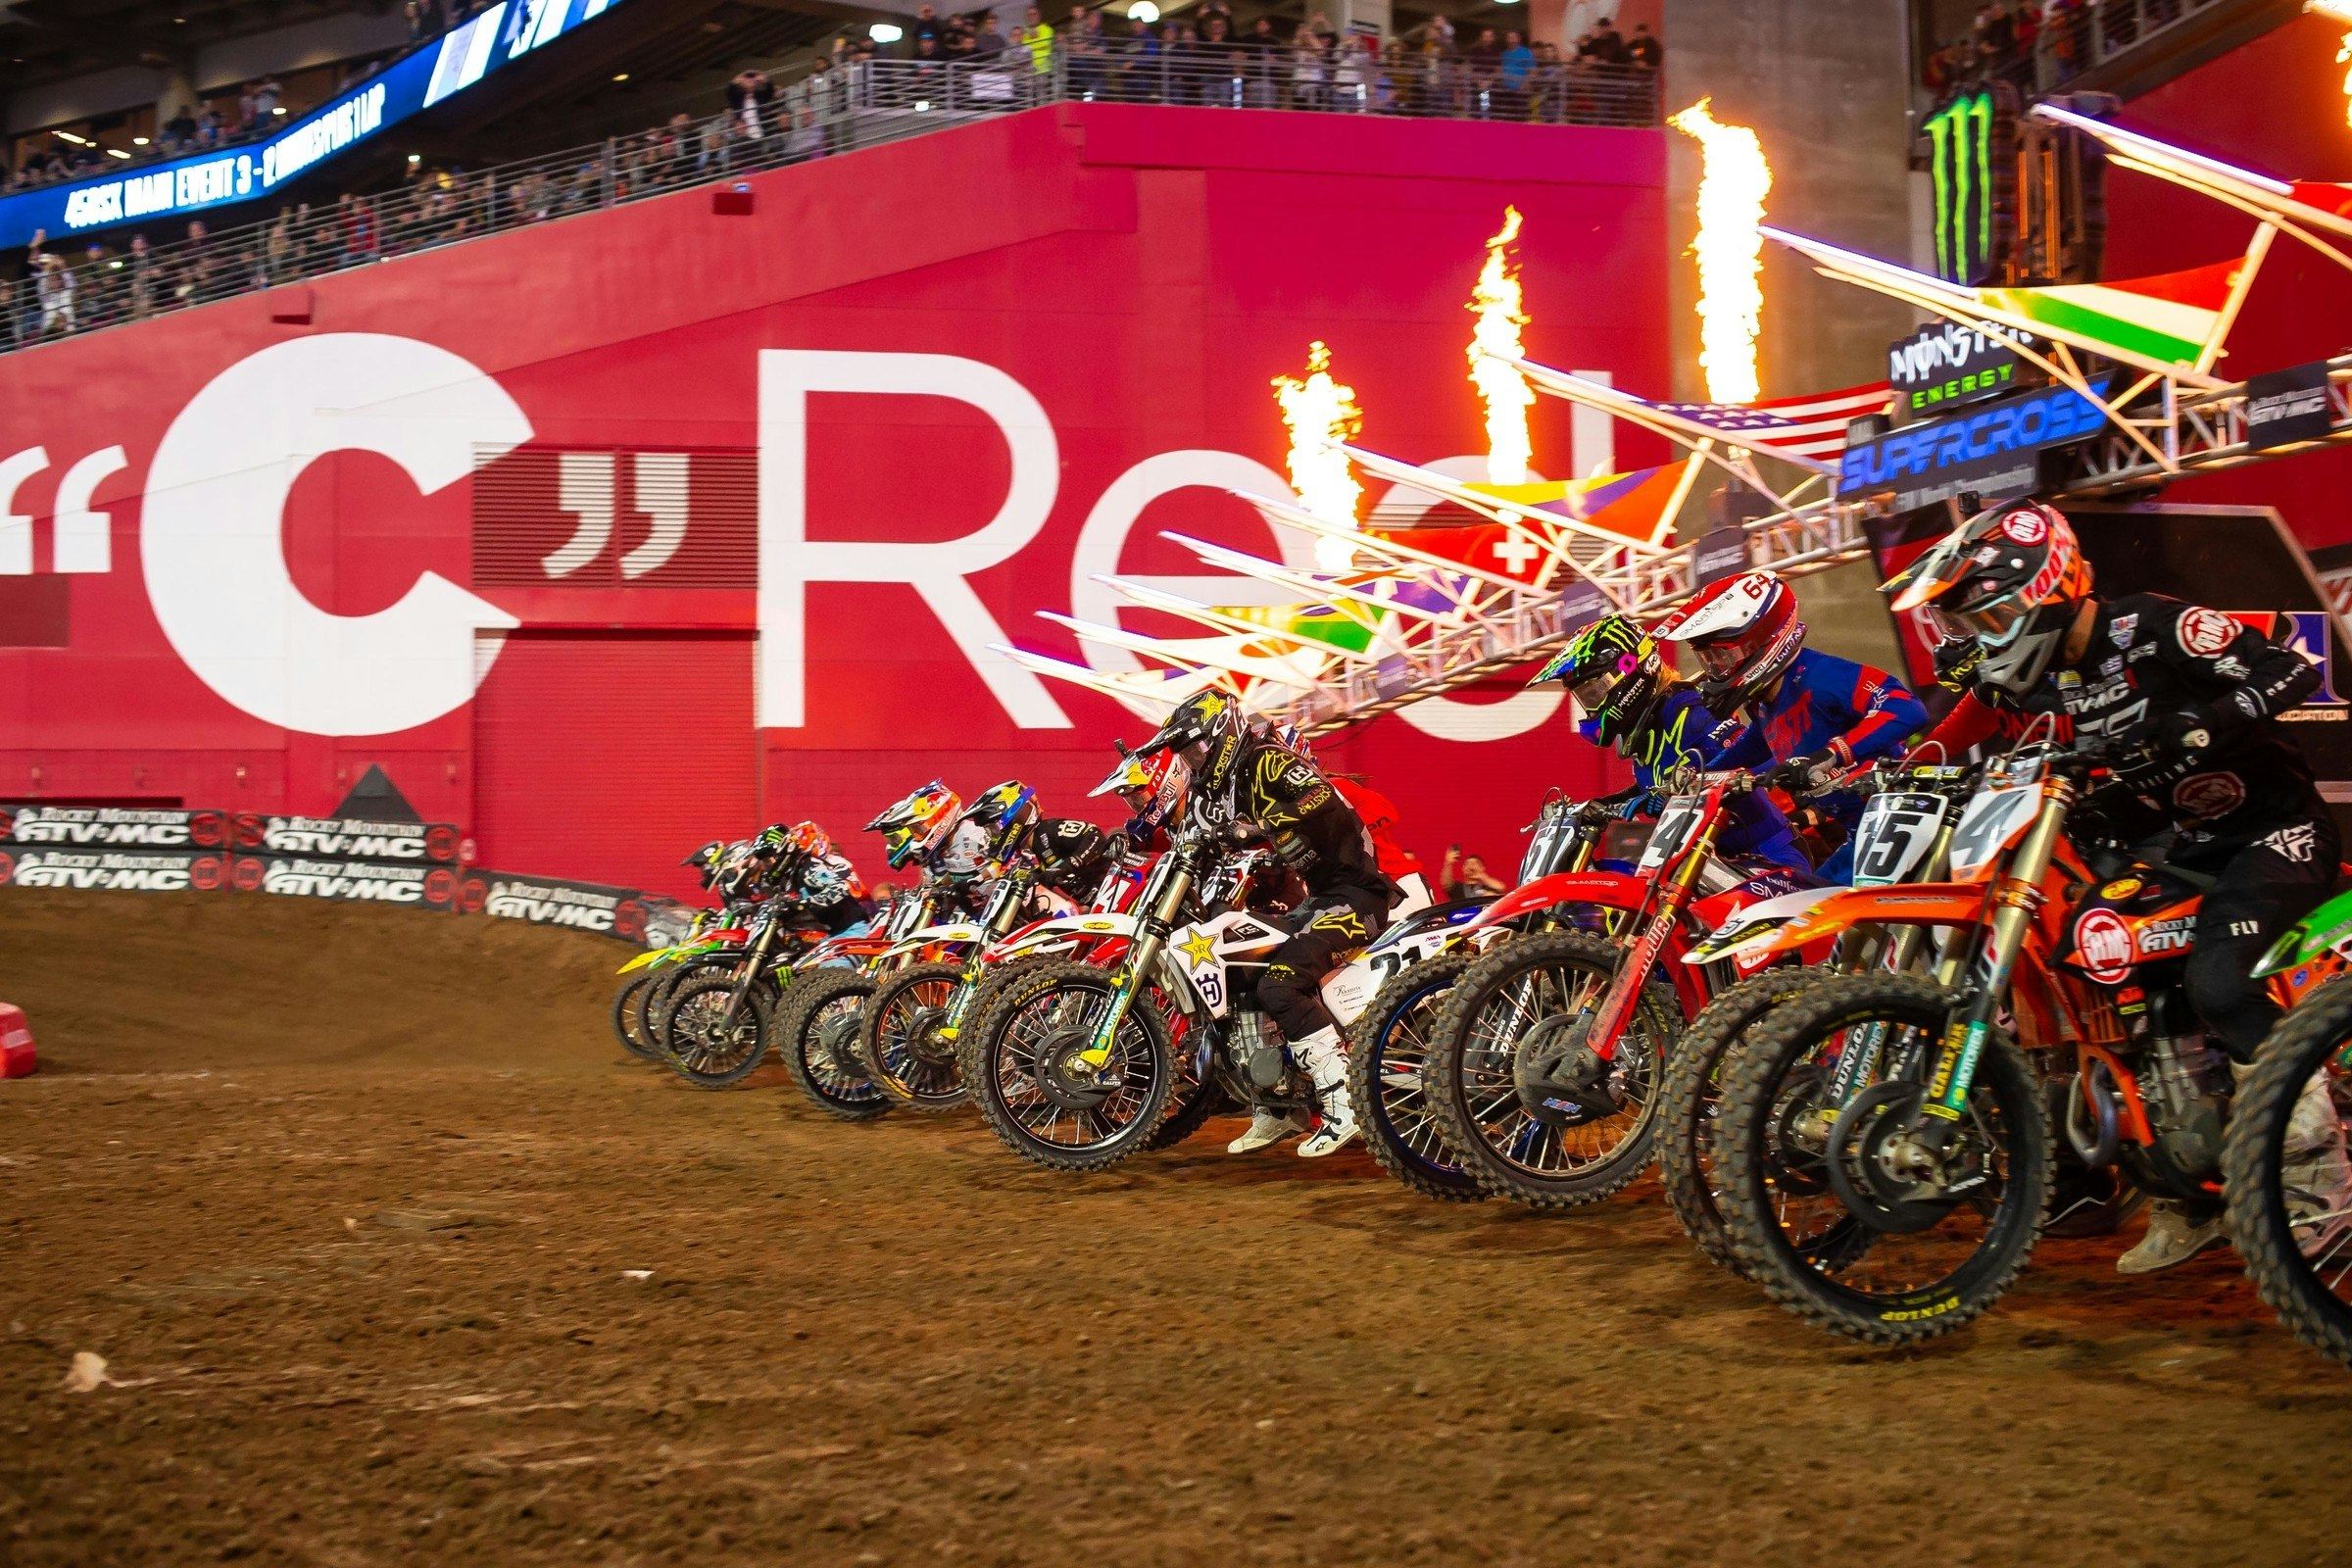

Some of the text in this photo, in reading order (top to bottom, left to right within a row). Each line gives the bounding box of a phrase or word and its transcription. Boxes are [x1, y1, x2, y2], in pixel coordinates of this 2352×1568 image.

[64, 181, 124, 228] 450SX
[123, 171, 174, 218] MAIN
[175, 157, 235, 207] EVENT
[236, 155, 252, 195] 3
[1890, 319, 2034, 383] MONSTER
[1912, 363, 2014, 410] ENERGY
[1838, 380, 2110, 493] SUPERCROSS
[1742, 572, 1774, 600] 64
[1618, 676, 1645, 707] MONSTER
[1152, 768, 1164, 788] FOX
[1855, 812, 1924, 878] 15
[1952, 789, 2030, 866] 4
[1013, 979, 1057, 1007] DUNLOP
[1102, 991, 1128, 1037] MOTOREX
[1956, 1028, 1986, 1090] MOTOREX
[1880, 1296, 1959, 1322] DUNLOP
